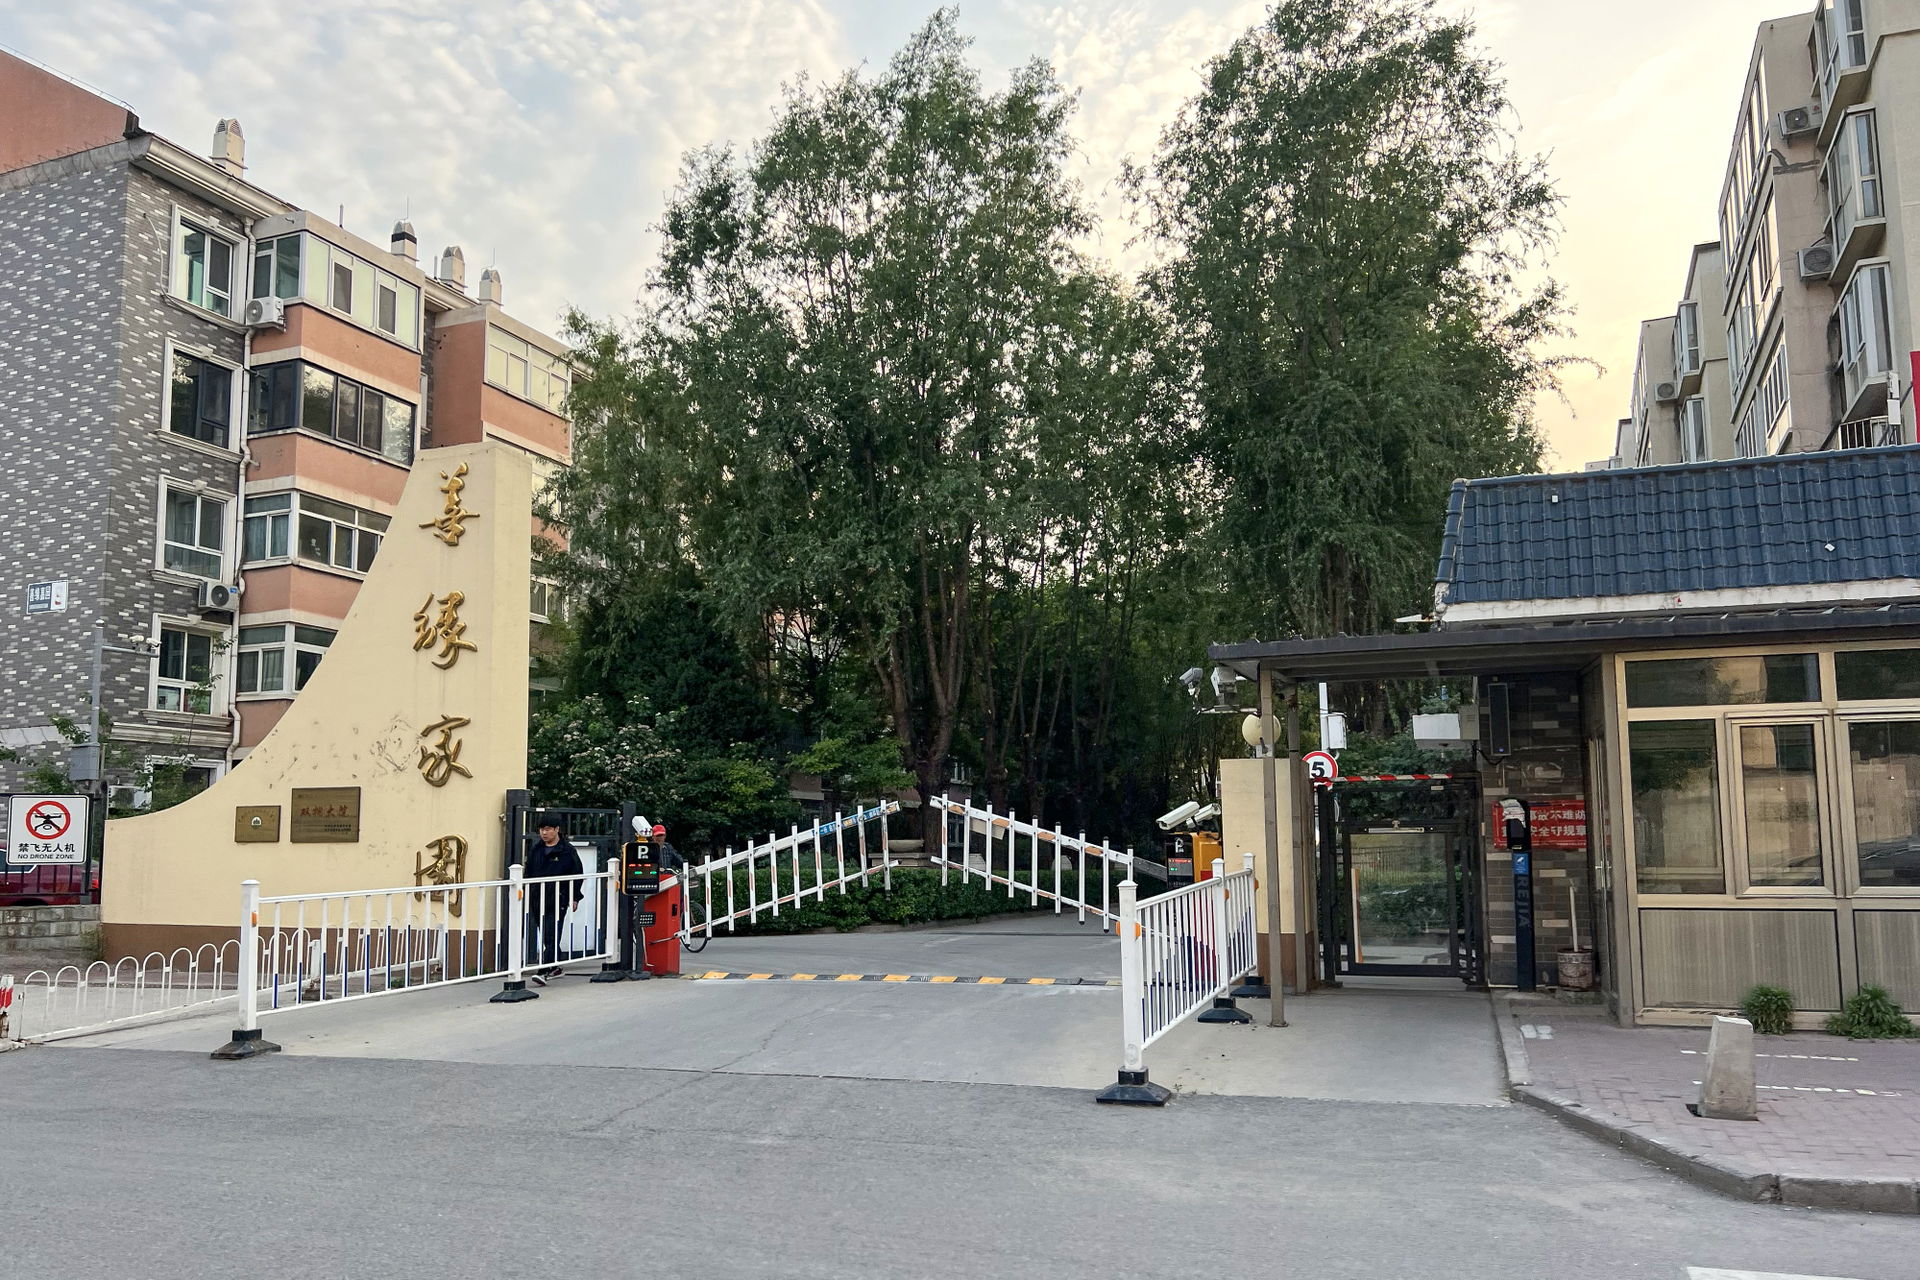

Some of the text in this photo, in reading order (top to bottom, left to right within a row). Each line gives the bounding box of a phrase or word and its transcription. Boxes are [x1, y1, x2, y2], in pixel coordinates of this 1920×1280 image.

[1311, 761, 1325, 778] 5
[18, 843, 75, 853] 禁飞无人机
[637, 845, 649, 859] P
